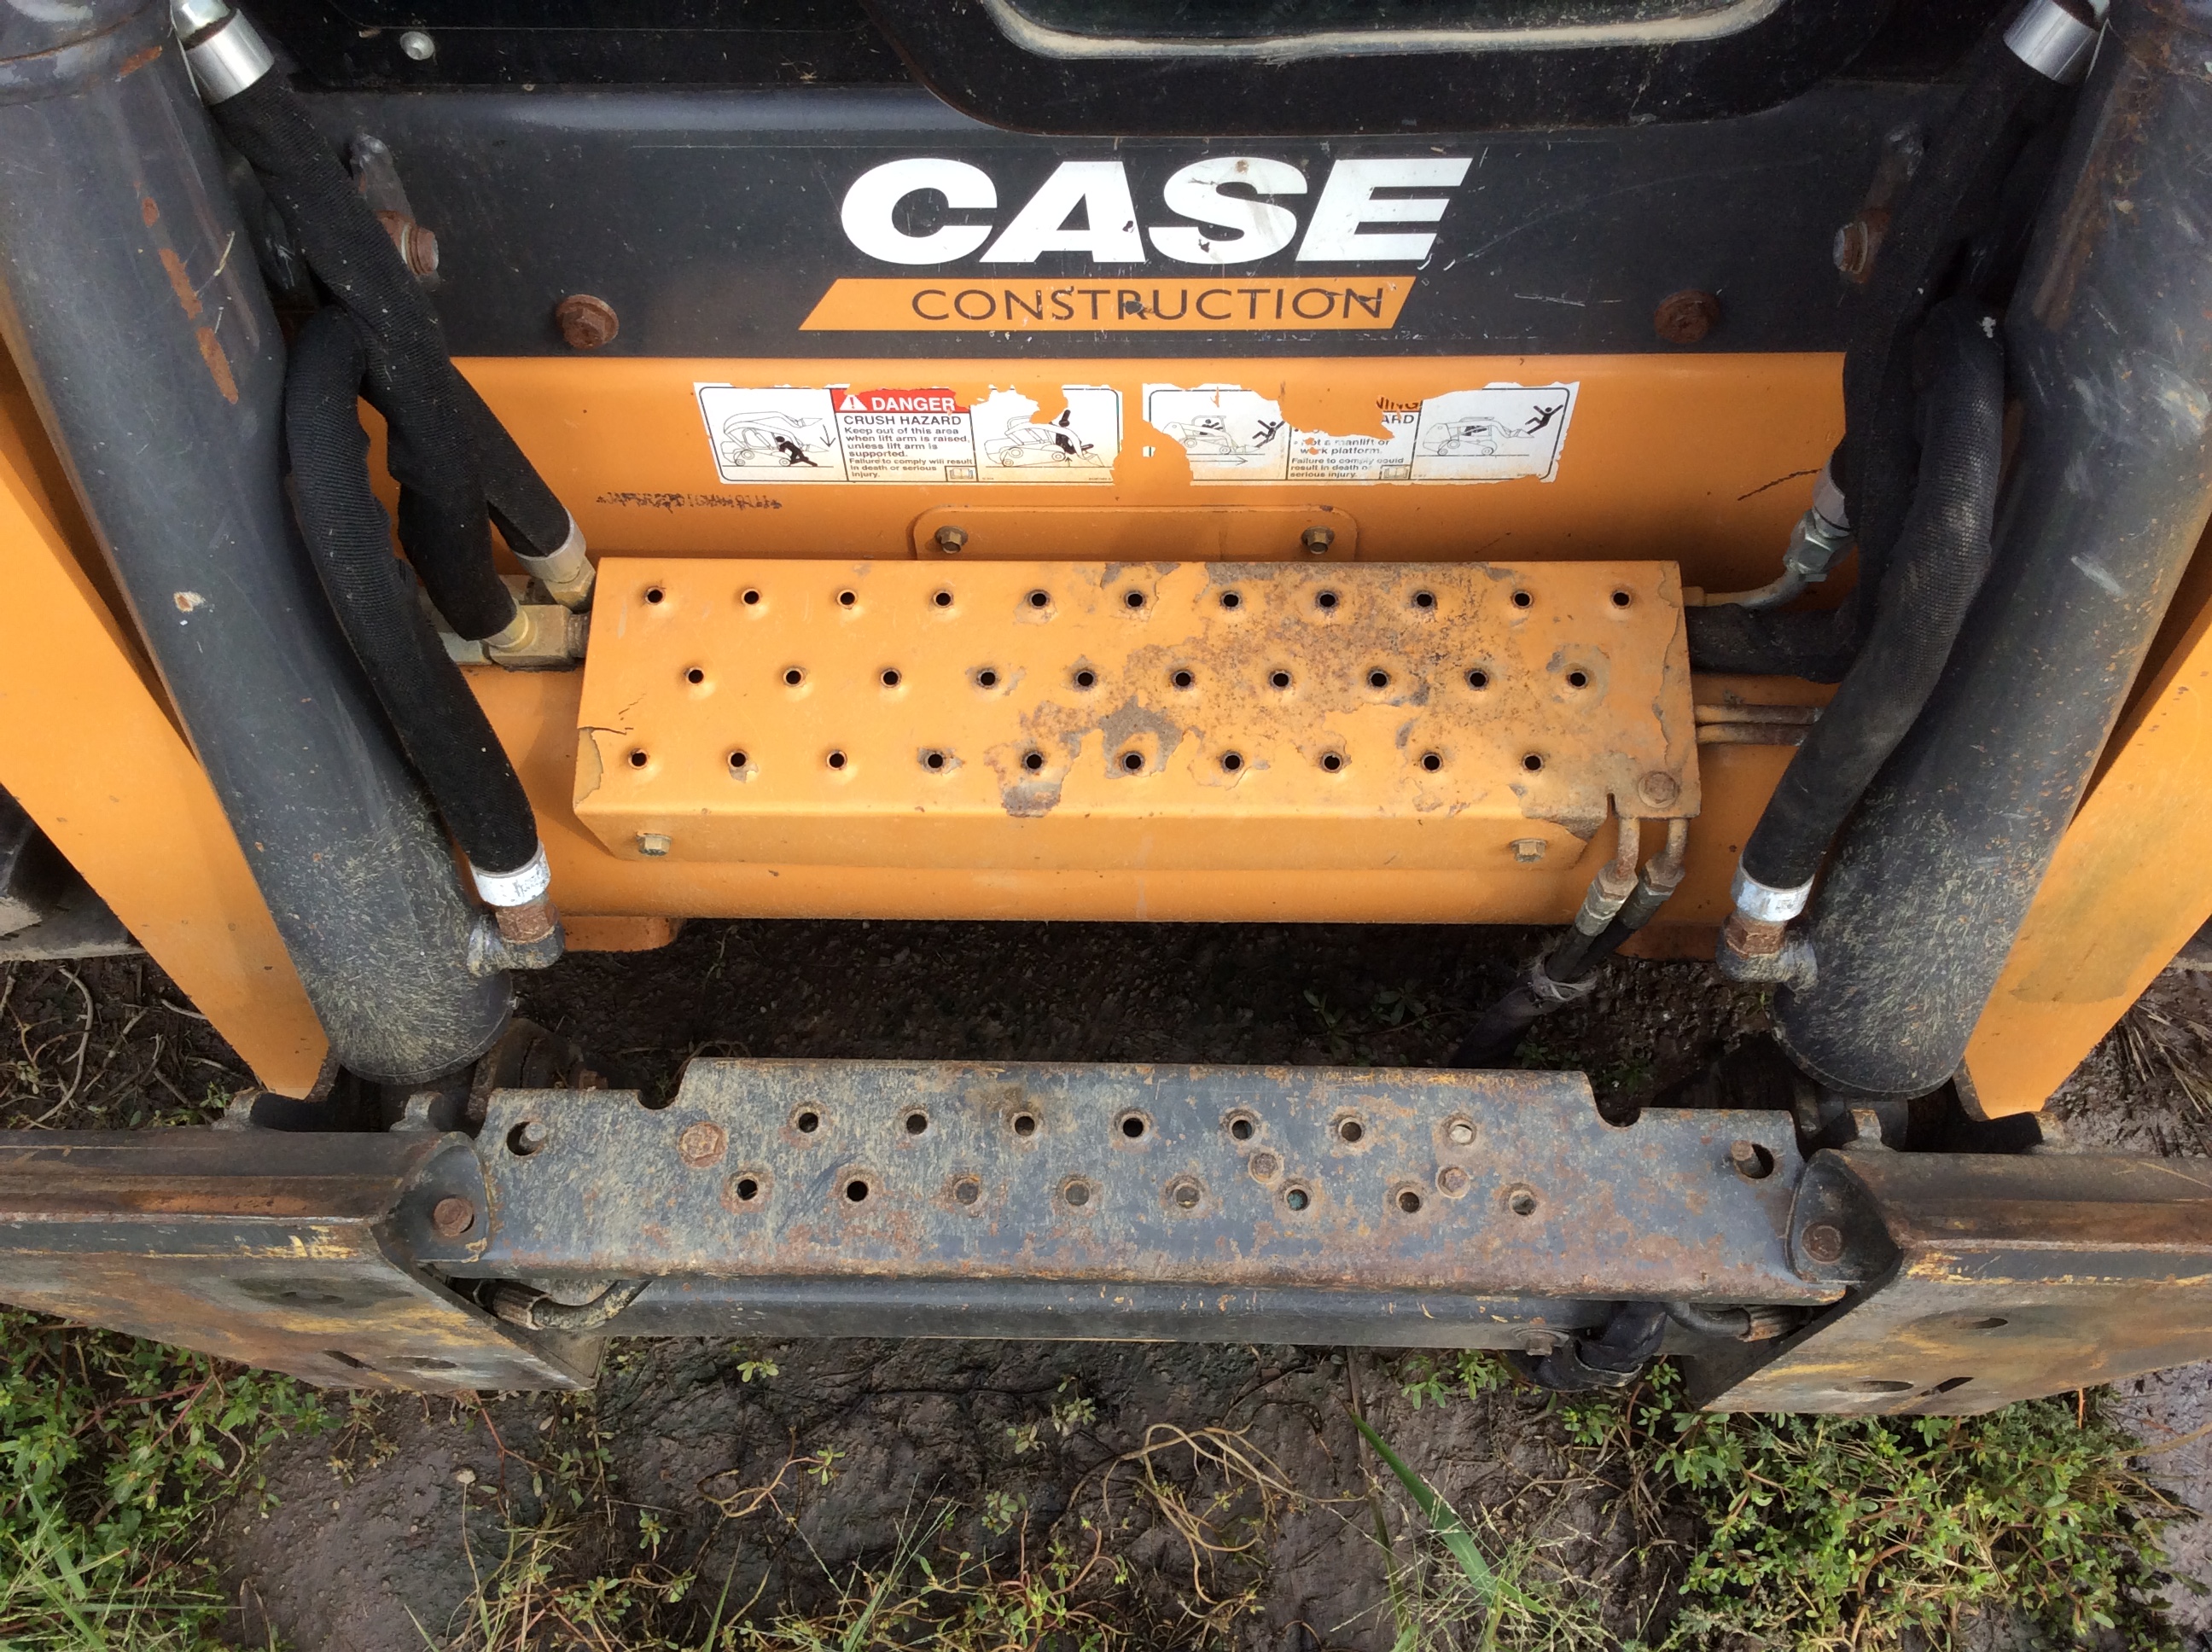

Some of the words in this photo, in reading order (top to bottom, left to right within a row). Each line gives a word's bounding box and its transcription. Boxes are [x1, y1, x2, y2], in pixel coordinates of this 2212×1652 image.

[841, 157, 1473, 265] CASE
[912, 288, 1382, 322] CONSTRUCTION
[871, 397, 956, 411] DANGER
[843, 416, 895, 425] CRUSH
[900, 416, 962, 425] HAZARD
